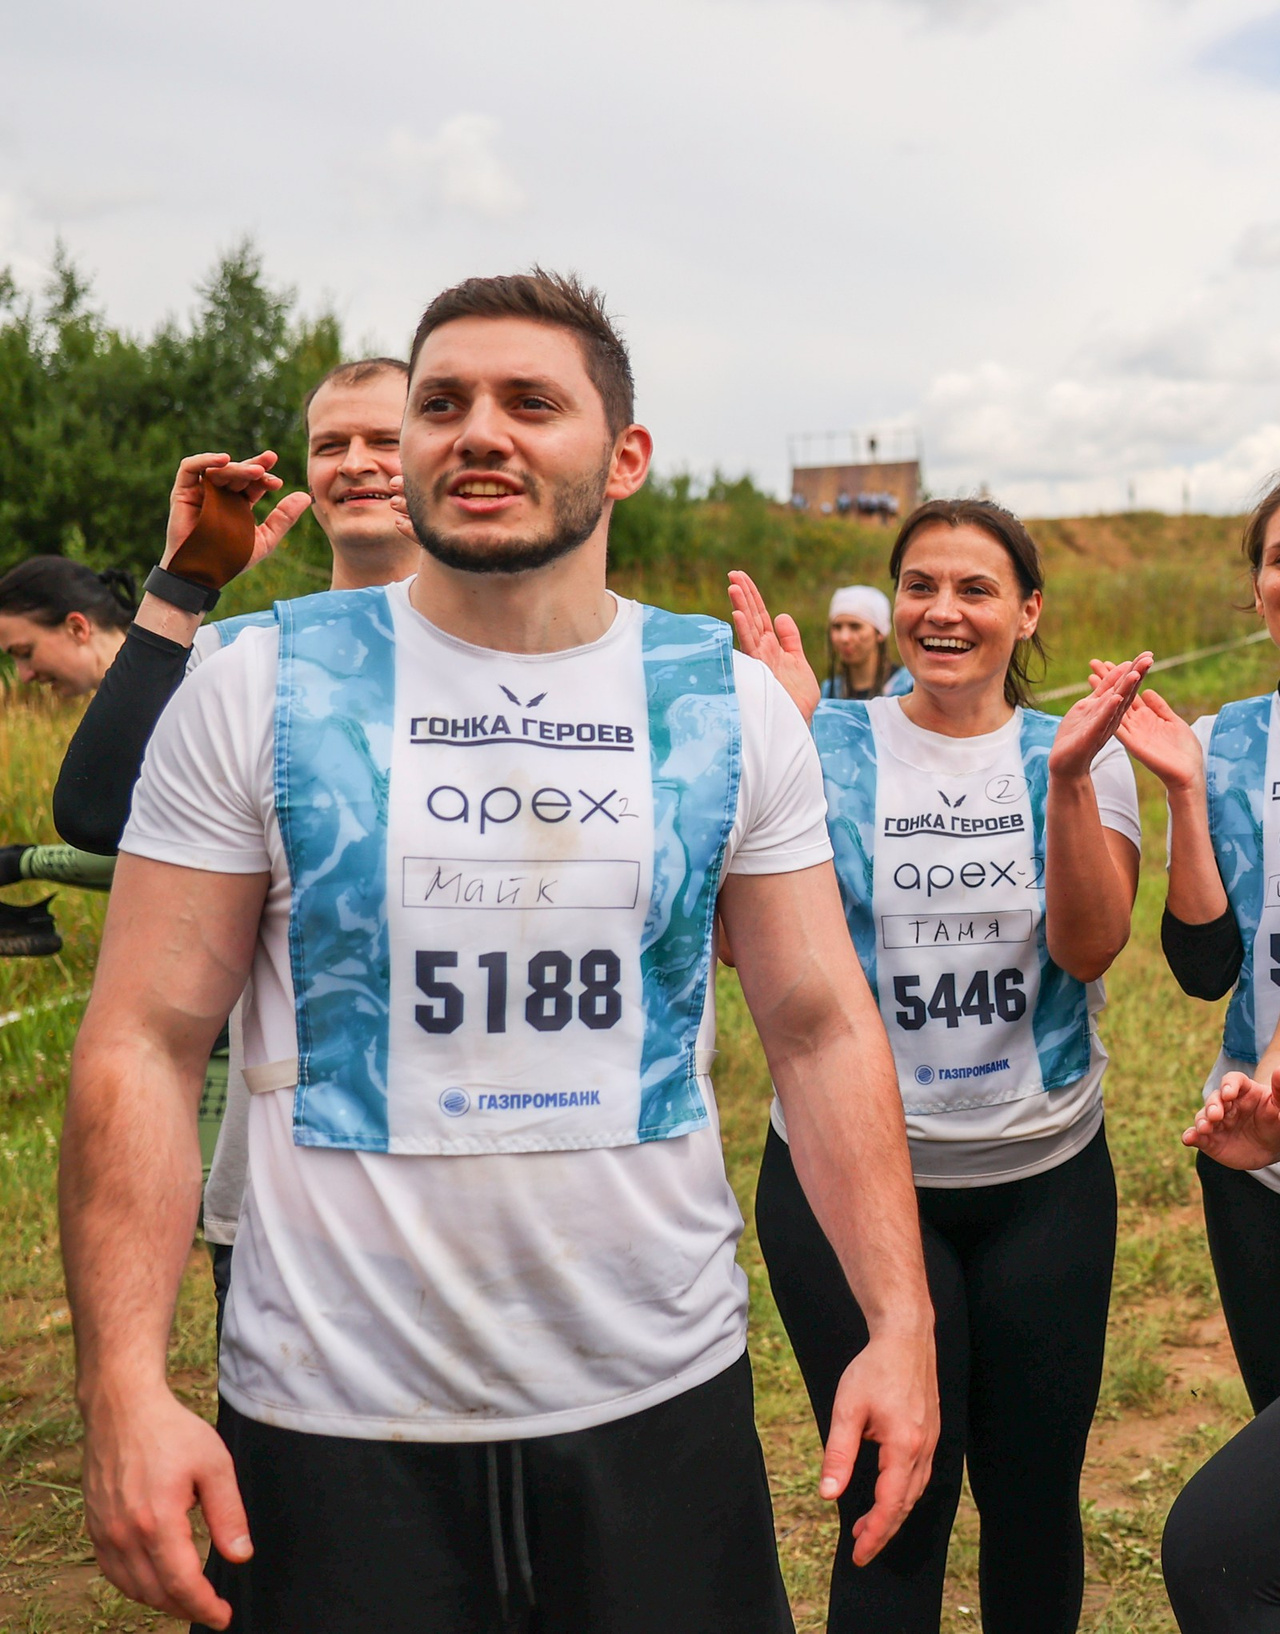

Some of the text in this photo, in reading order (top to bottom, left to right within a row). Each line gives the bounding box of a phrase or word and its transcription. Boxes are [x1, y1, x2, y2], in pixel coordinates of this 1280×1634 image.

[410, 714, 635, 745] ГОНКА ГЕРОЕВ
[996, 780, 1015, 799] 2
[426, 785, 640, 834] apex 2
[884, 812, 1025, 833] ГОНКА ГЕРОЕВ
[894, 860, 1017, 897] apex
[414, 949, 622, 1035] 5188
[893, 968, 1027, 1031] 5446
[938, 1059, 1011, 1081] ГАЗПРОМБАНК
[478, 1089, 601, 1111] ГАЗПРОМБАНК
